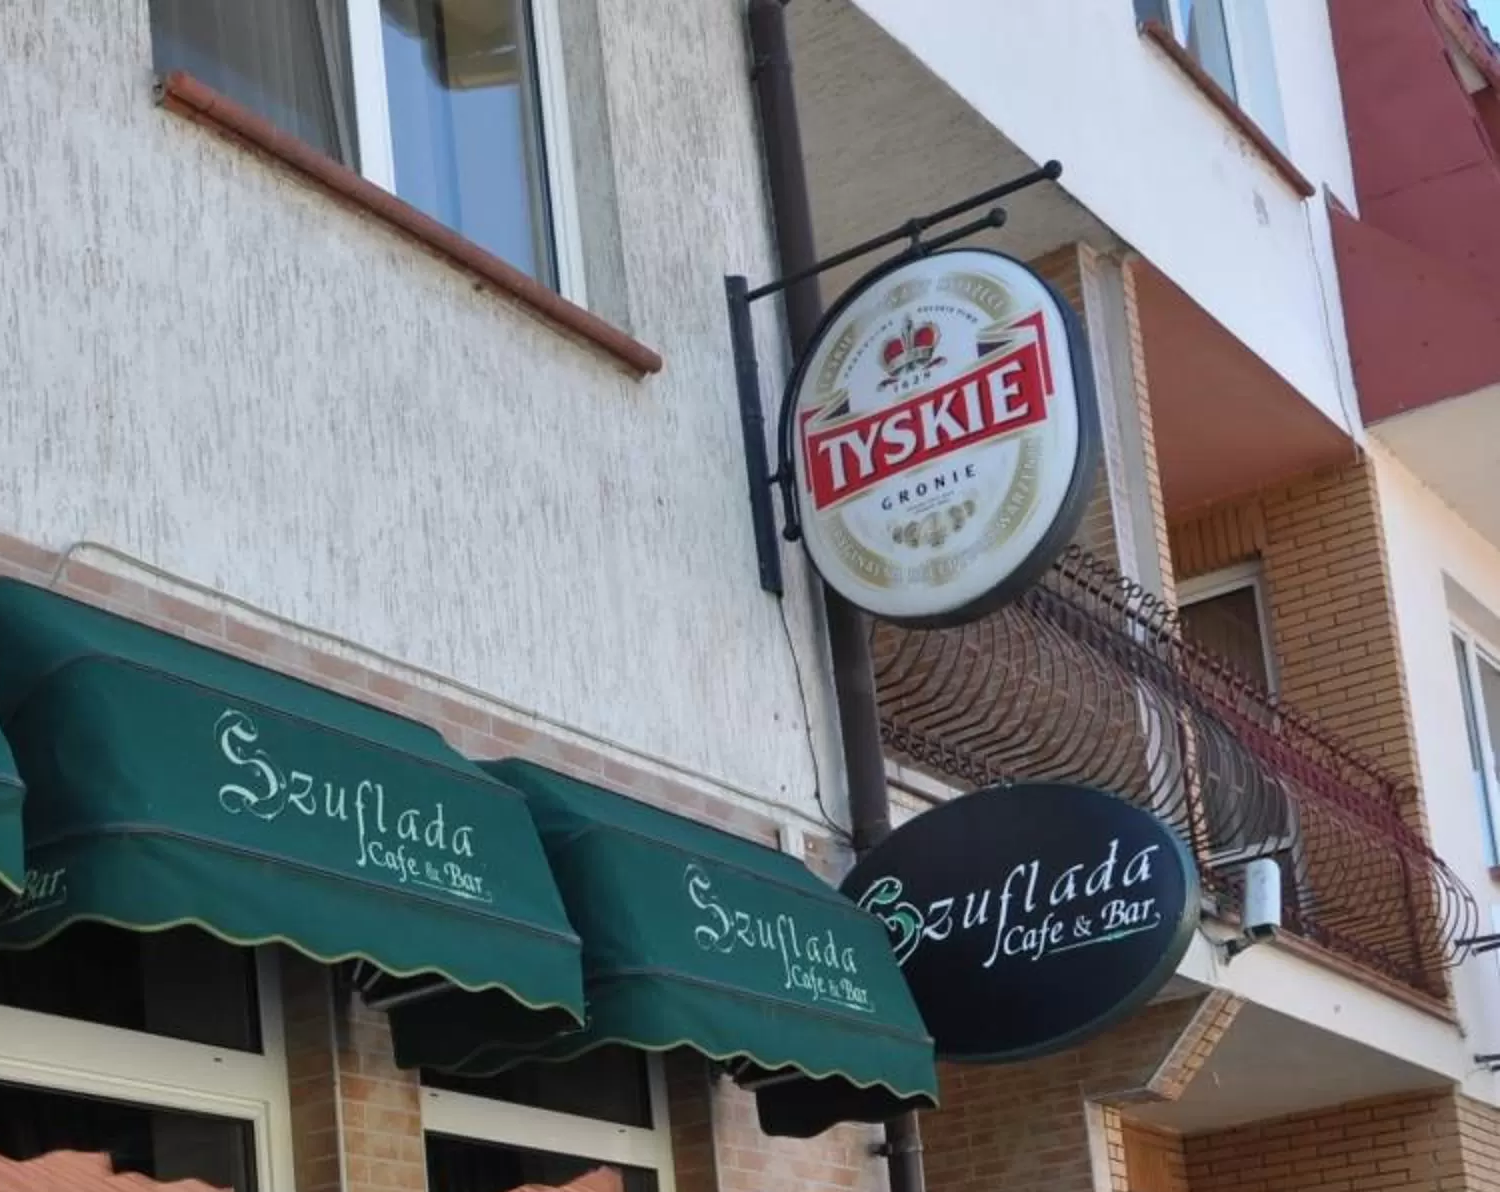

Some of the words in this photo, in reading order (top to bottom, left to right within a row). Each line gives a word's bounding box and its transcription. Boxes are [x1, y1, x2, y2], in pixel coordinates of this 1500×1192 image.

[818, 360, 1029, 491] TYSKIE
[881, 463, 978, 512] GRONIE
[212, 708, 475, 868] Szuflada
[368, 841, 420, 883] Cafe
[444, 861, 484, 894] Bar
[682, 862, 858, 990] Szuflada
[1003, 914, 1063, 962] Cafe
[1073, 915, 1093, 937] &
[1101, 896, 1156, 931] Bar
[791, 963, 827, 1001] Cafe
[839, 978, 869, 1005] Bar
